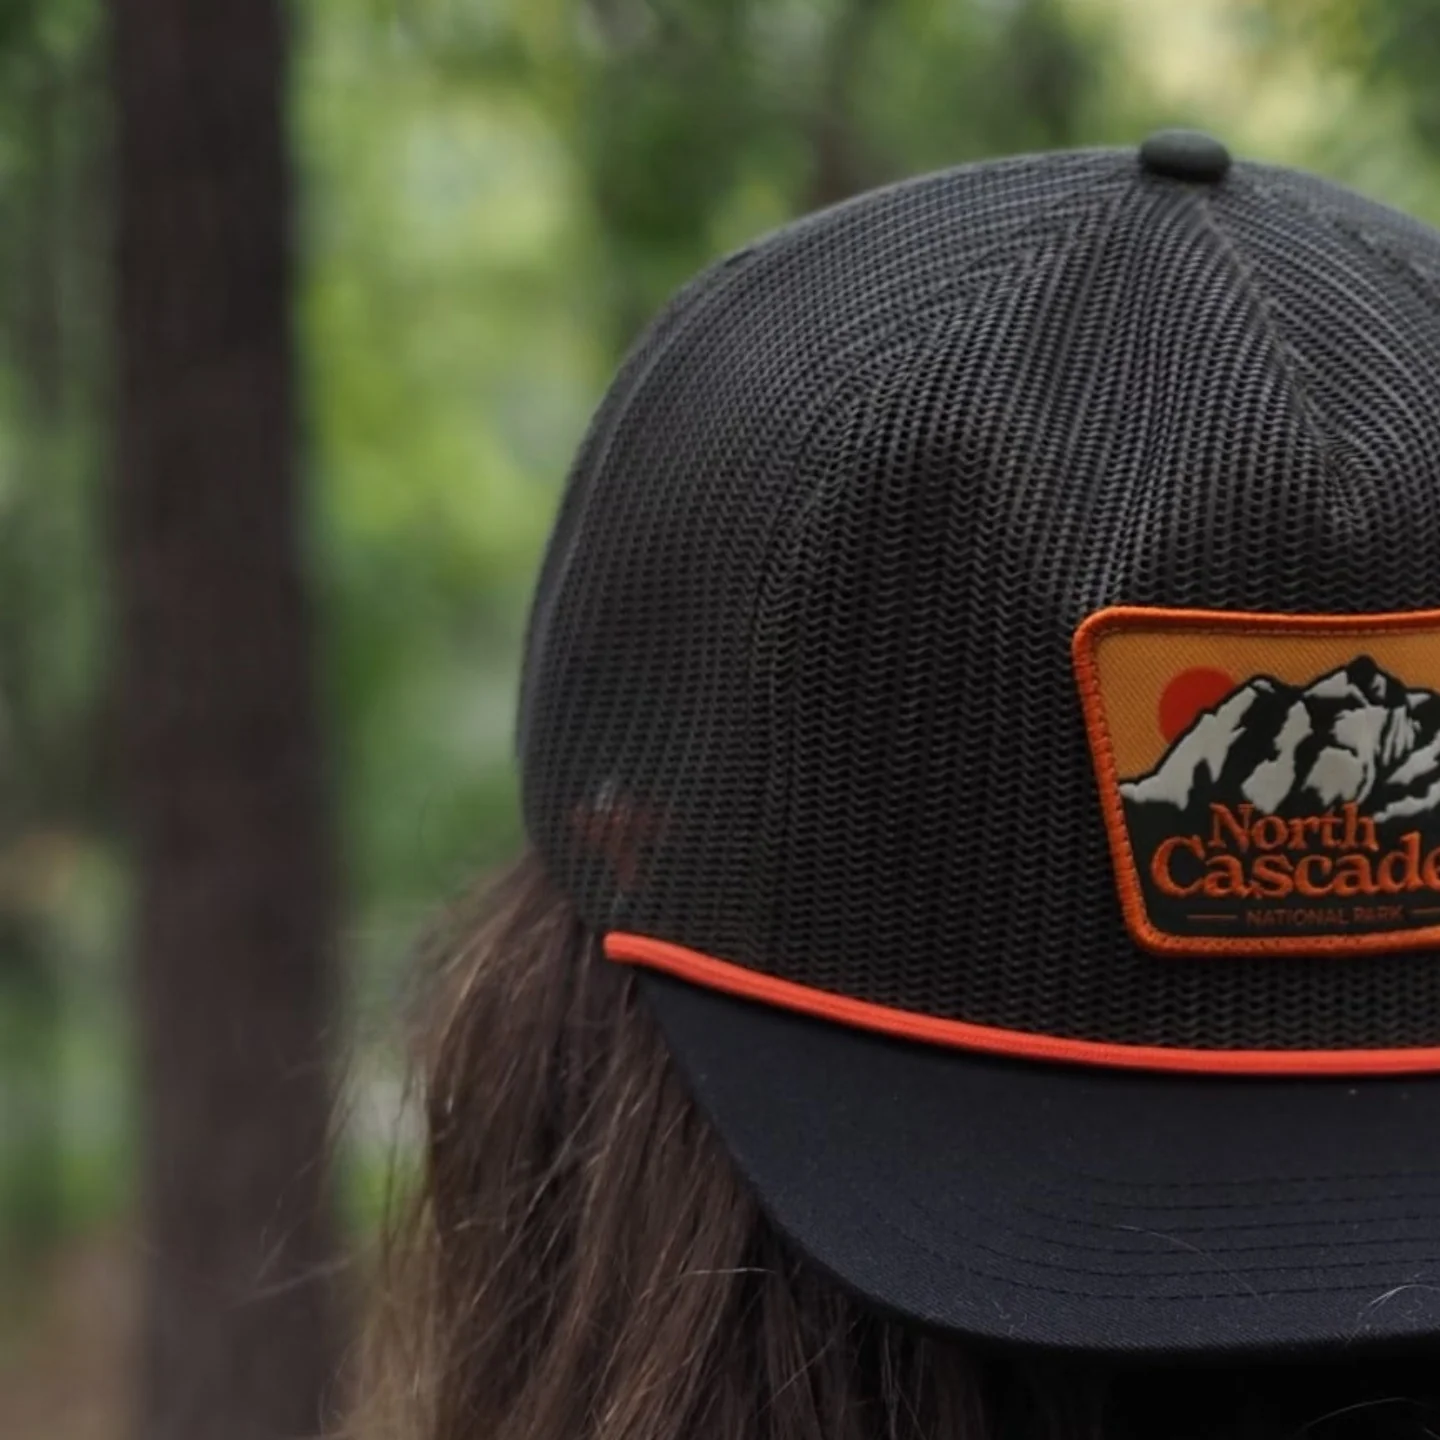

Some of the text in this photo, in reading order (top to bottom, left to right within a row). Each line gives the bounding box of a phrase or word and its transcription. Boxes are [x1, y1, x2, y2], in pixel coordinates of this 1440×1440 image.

[1208, 802, 1378, 852] North
[1245, 905, 1405, 926] NATIONAL PARK
